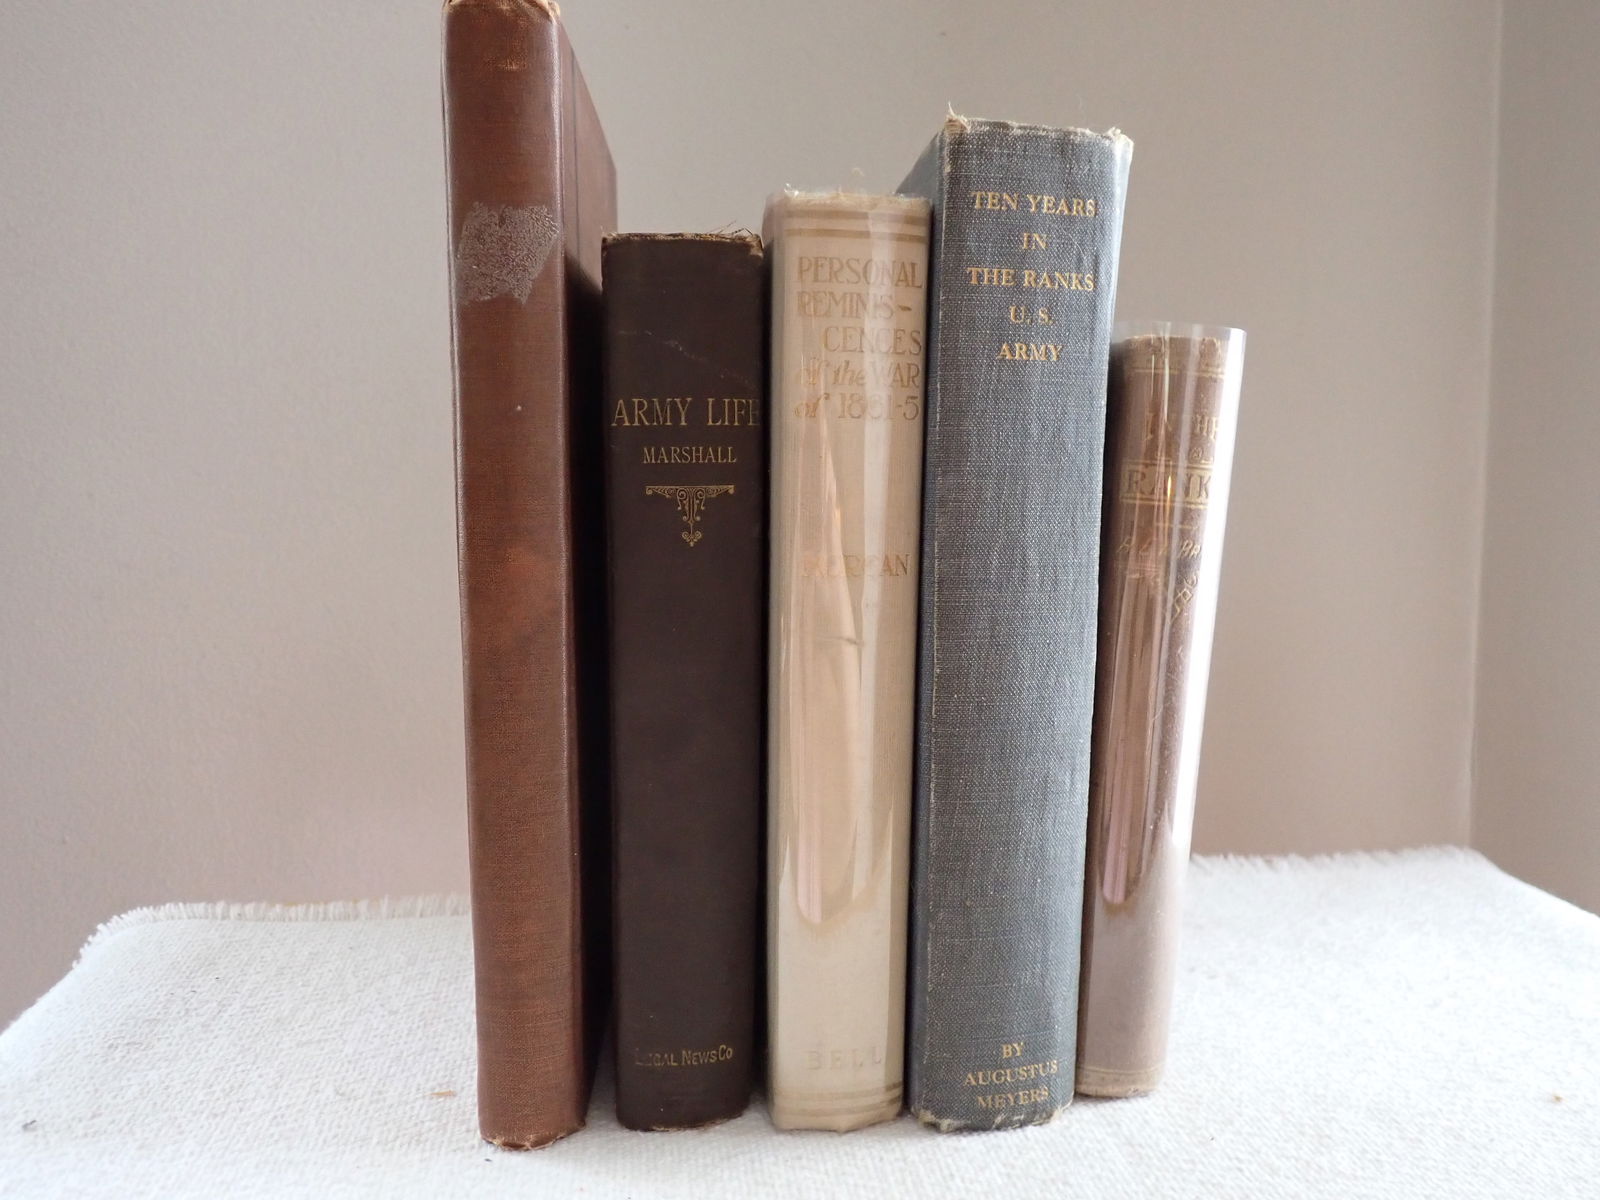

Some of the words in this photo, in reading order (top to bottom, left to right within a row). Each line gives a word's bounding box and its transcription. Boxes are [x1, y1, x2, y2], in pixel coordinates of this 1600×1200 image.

[971, 190, 1020, 211] TEN
[1026, 193, 1098, 218] YEARS
[1021, 232, 1048, 250] IN
[796, 256, 923, 289] PERSONAL
[966, 266, 1016, 286] THE
[1023, 269, 1095, 291] RANKS
[822, 326, 922, 357] CENCES
[996, 342, 1063, 362] ARMY
[832, 359, 867, 387] the
[869, 361, 921, 389] WAR
[610, 397, 693, 427] ARMY
[706, 397, 761, 427] LIFE
[642, 445, 738, 465] MARSHALL
[1001, 1041, 1025, 1060] BY
[963, 1059, 1059, 1087] AUGUSTUS
[976, 1084, 1050, 1109] MEYERS
